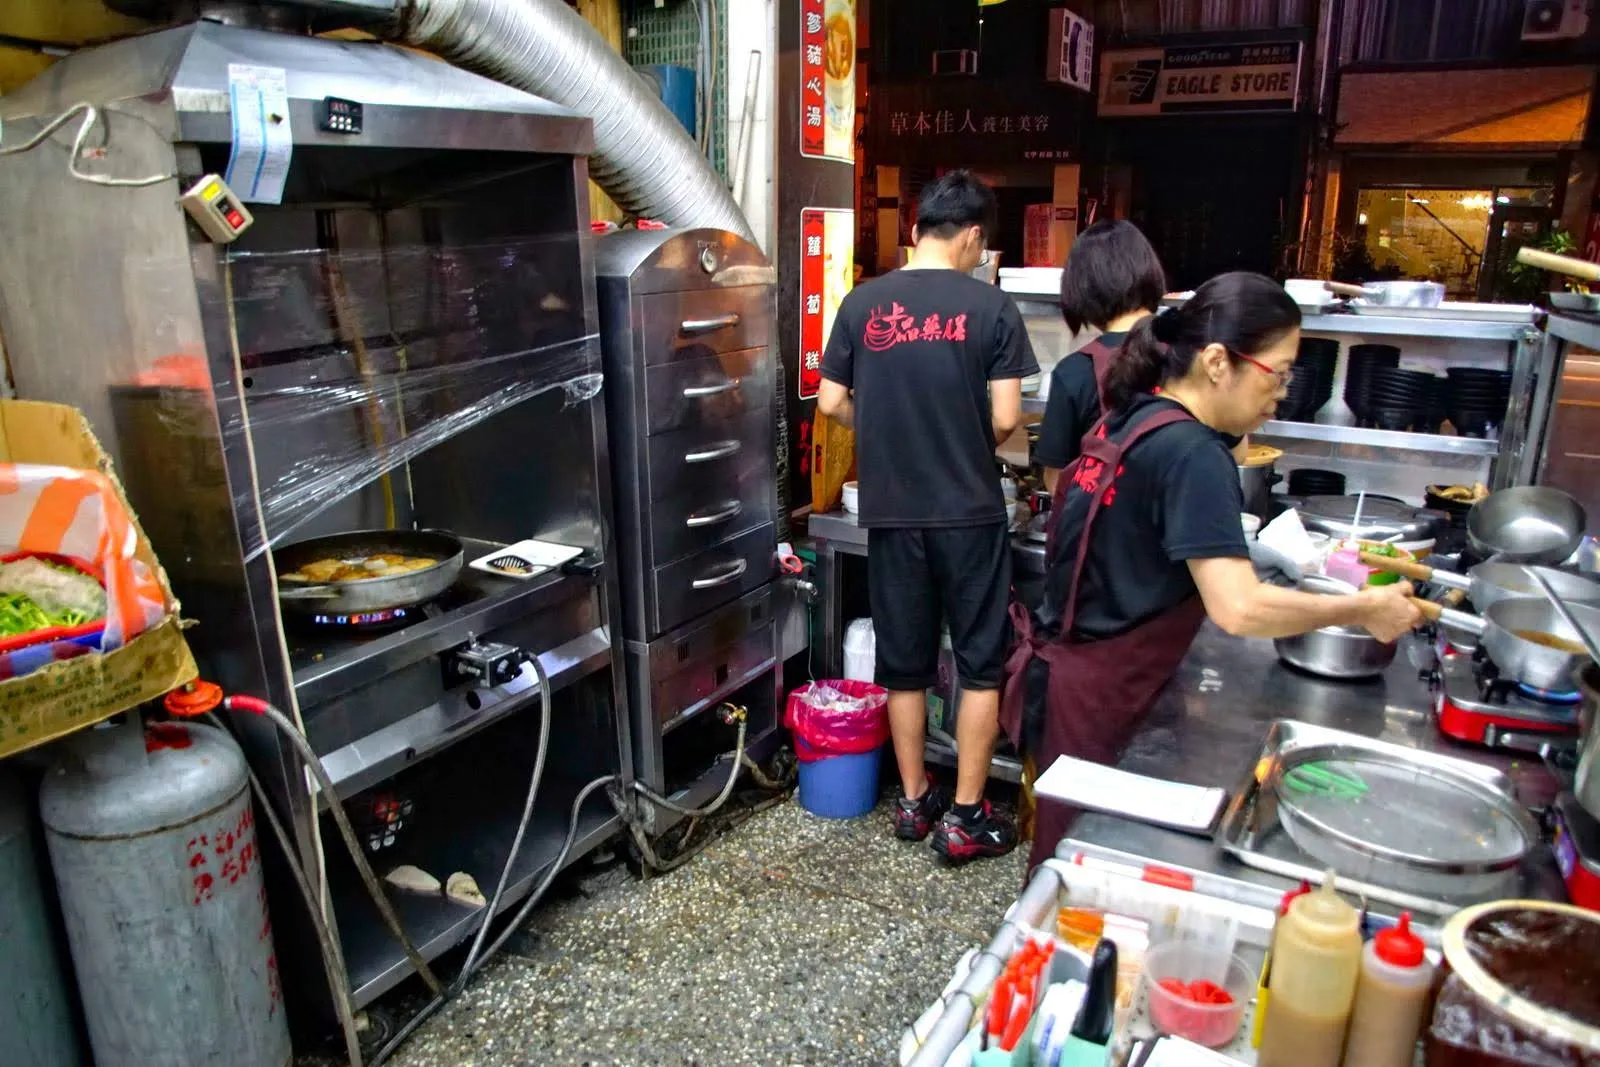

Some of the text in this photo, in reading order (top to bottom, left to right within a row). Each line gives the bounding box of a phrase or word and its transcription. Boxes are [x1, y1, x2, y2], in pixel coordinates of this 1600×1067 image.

[806, 0, 823, 127] 參豬心湯
[1166, 71, 1291, 95] EAGLE STORE
